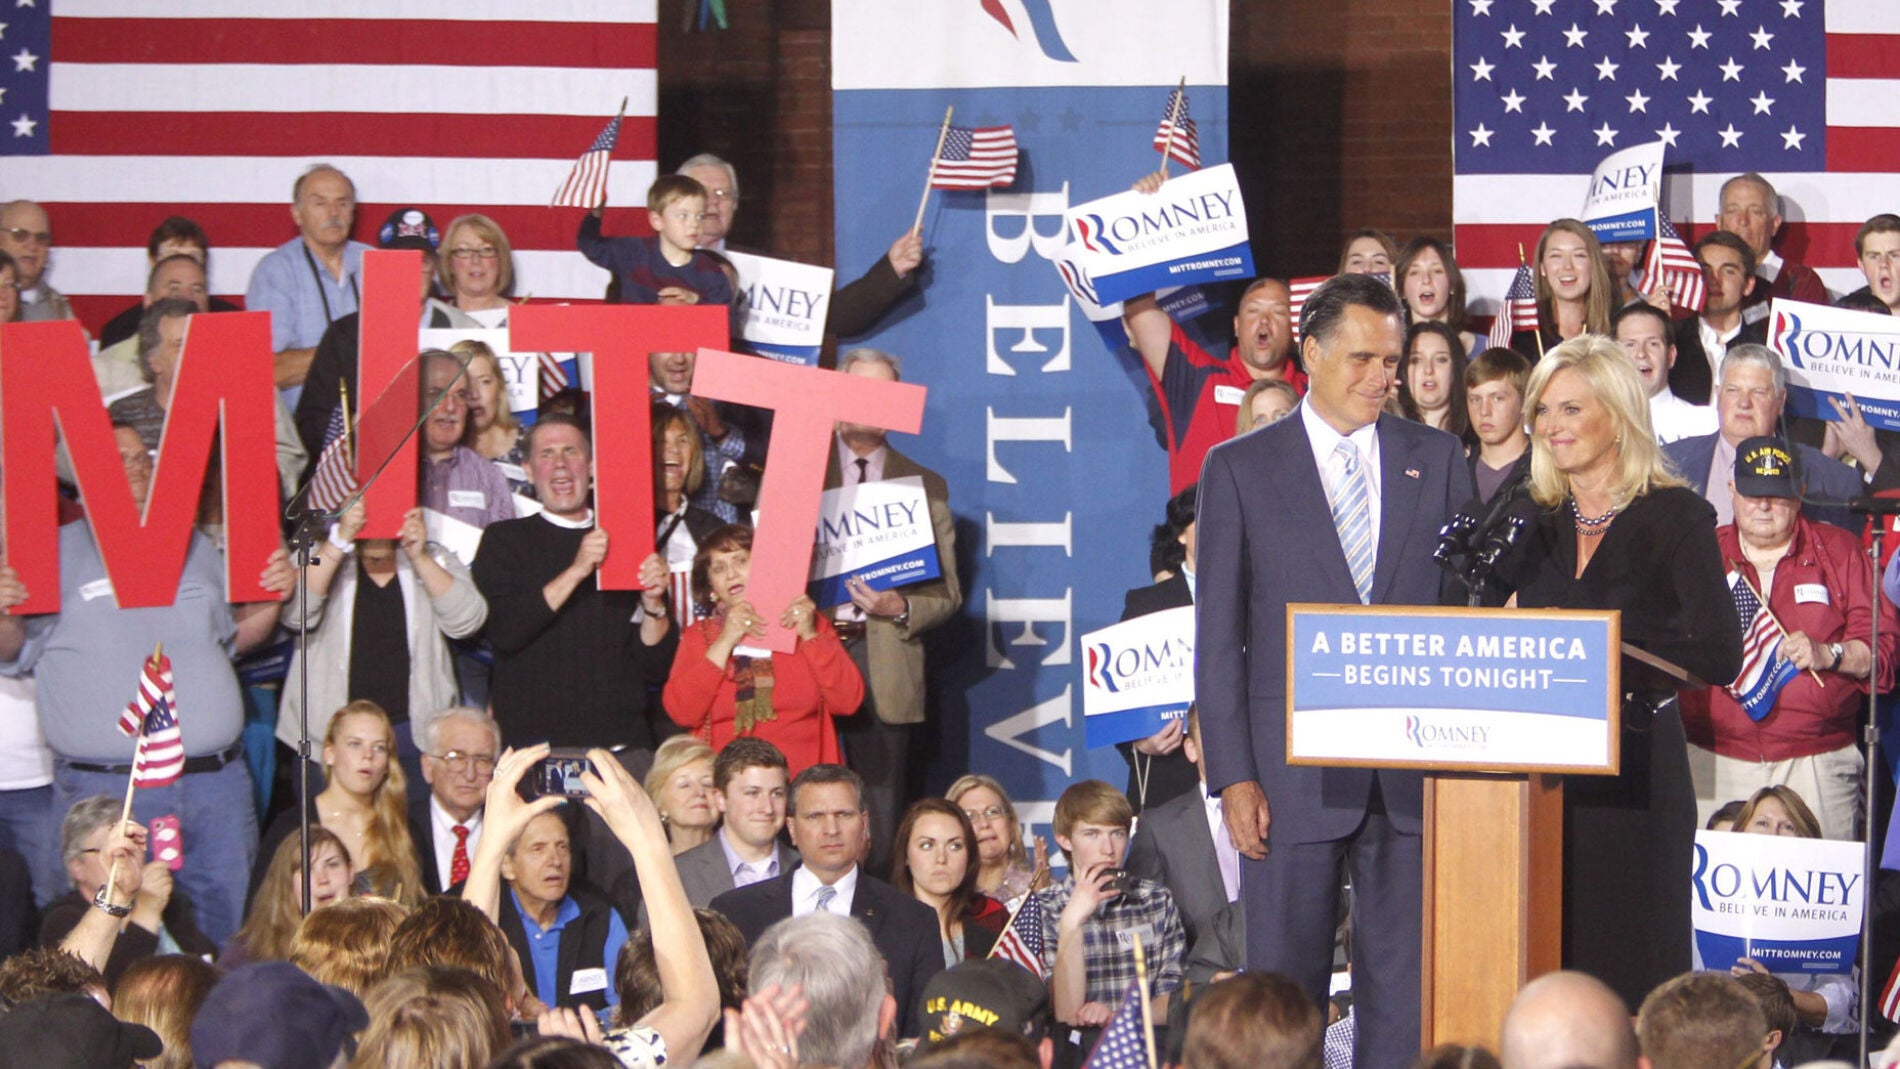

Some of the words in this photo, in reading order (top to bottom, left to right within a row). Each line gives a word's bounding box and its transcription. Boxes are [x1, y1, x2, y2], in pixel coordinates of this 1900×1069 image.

[1591, 163, 1656, 198] NEY
[1604, 190, 1647, 202] AMERICA
[1076, 189, 1233, 255] ROMNEY
[1175, 231, 1186, 240] IN
[1190, 221, 1237, 236] AMERICA
[1169, 256, 1243, 274] MITTROMNEY.COM
[764, 316, 810, 331] AMERICA
[1774, 311, 1900, 372] ROMN
[1811, 361, 1855, 376] BELIEVE
[1860, 371, 1870, 379] IN
[1874, 372, 1900, 384] AME
[1760, 447, 1771, 456] AIR
[815, 500, 919, 545] MNEY
[853, 539, 864, 549] IN
[868, 529, 917, 545] AMERICA
[860, 559, 925, 583] TROMNEY.COM
[1311, 631, 1331, 654] A
[1340, 632, 1446, 657] BETTER
[1455, 635, 1587, 660] AMERICA
[1344, 665, 1432, 687] BEGINS
[1440, 667, 1553, 690] TONIGHT
[1406, 715, 1491, 748] ROMNEY
[1775, 907, 1786, 917] IN
[1791, 908, 1848, 921] AMERICA
[1751, 947, 1842, 960] MITTROMNEY.COM
[950, 999, 999, 1026] ARMY
